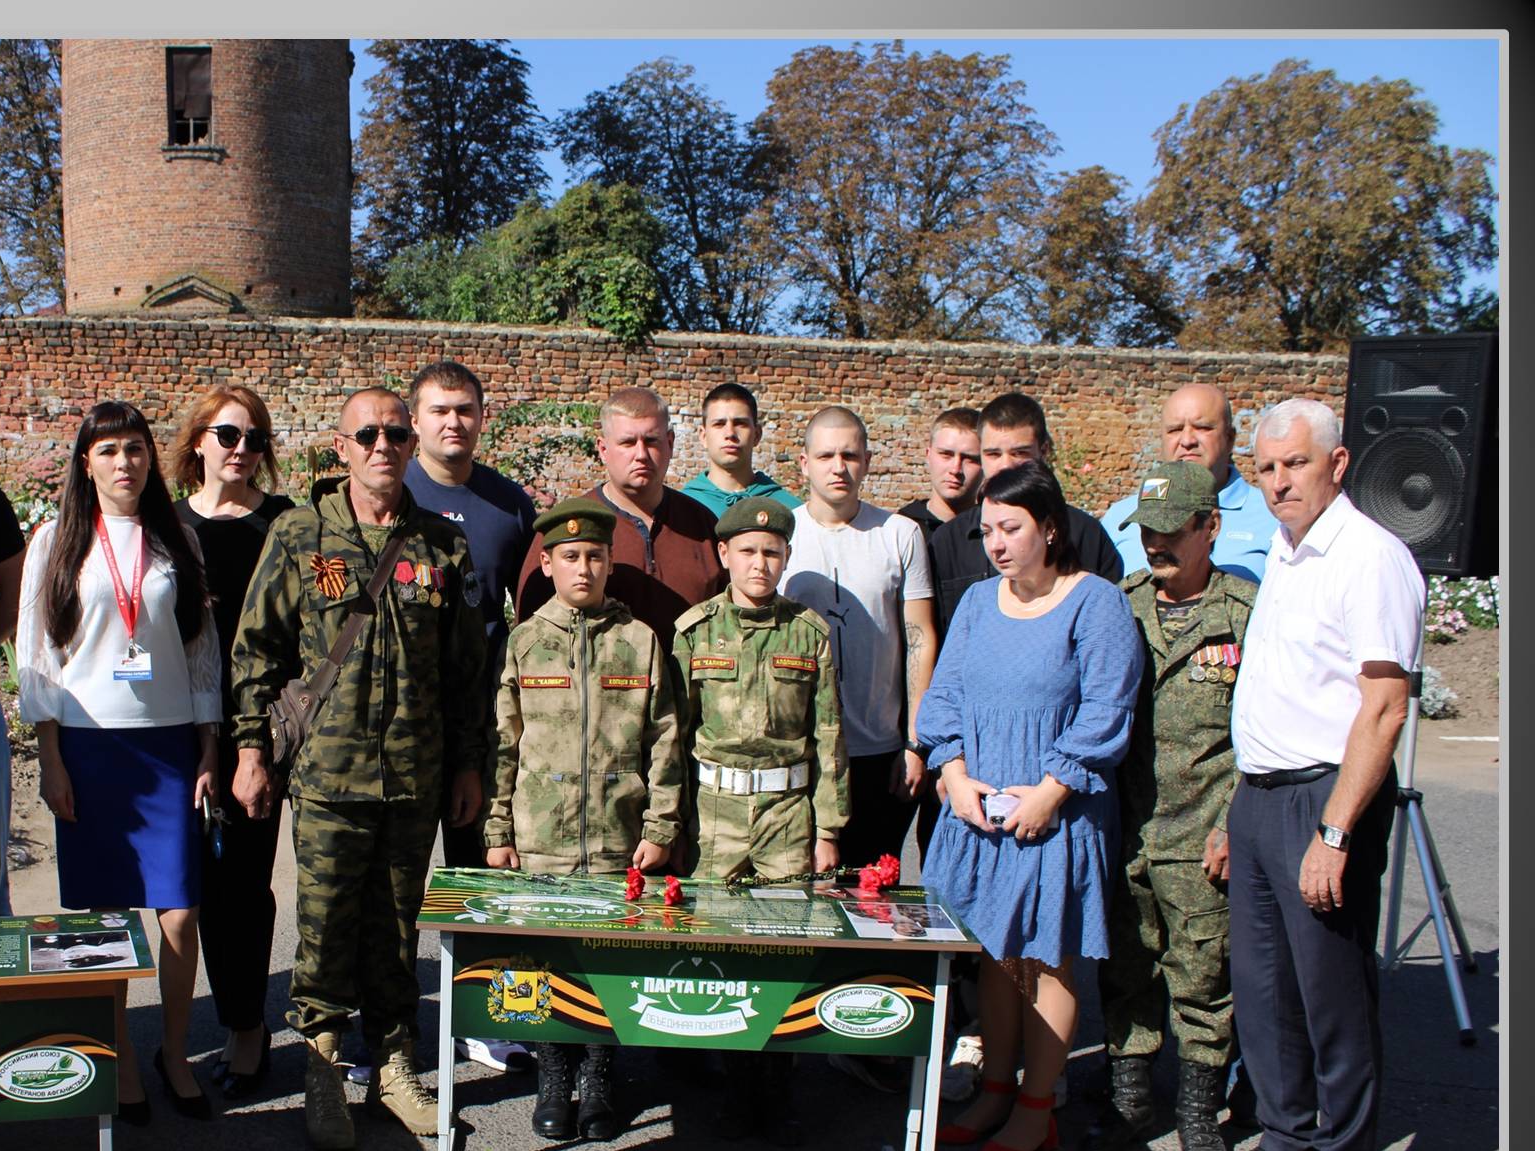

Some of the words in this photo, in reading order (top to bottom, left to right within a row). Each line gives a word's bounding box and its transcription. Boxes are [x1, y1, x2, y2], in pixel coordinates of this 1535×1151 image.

[582, 938, 671, 950] Кривошеев
[676, 941, 726, 953] Роман
[729, 944, 814, 957] Андреевич
[643, 976, 695, 994] ПАРТА
[698, 980, 747, 997] ГЕРОЯ
[823, 989, 863, 1011] РОССИЙСКИЙ
[864, 989, 883, 997] СОЮЗ
[645, 1013, 694, 1030] ОБЪЕДИНЯЯ
[694, 1016, 743, 1030] ПОКОЛЕНИЯ
[831, 1019, 865, 1033] ВЕТЕРАНОВ
[866, 1015, 905, 1033] АФГАНИСТАНА
[8, 1085, 46, 1096] ВЕТЕРАНОВ
[47, 1074, 88, 1096] АФГАНИСТАНА
